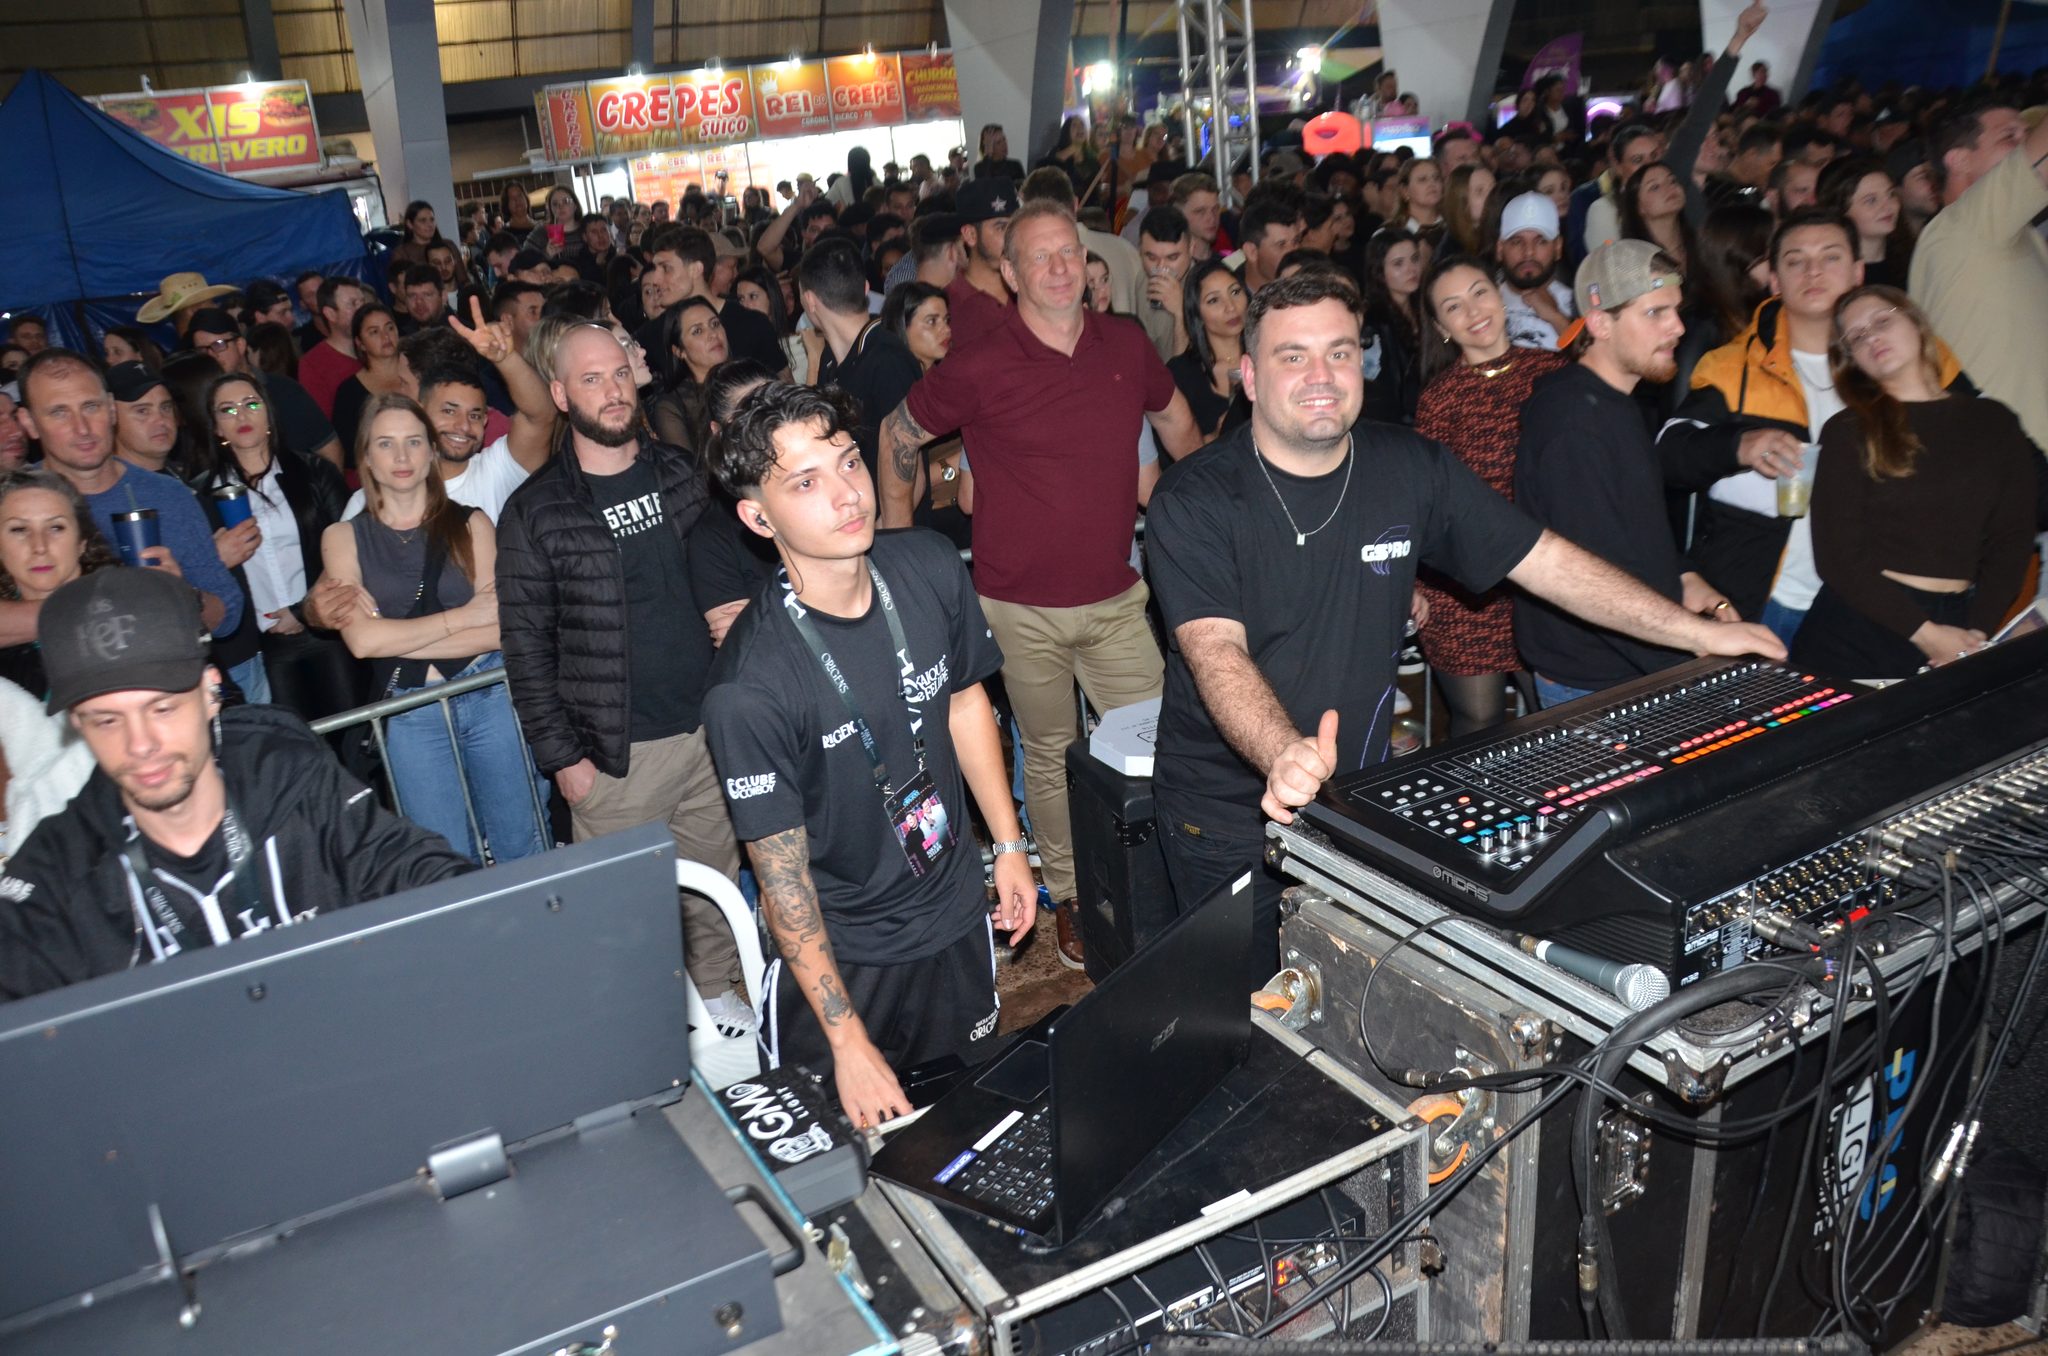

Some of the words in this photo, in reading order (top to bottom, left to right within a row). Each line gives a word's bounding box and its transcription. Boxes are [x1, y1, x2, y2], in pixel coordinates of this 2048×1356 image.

[598, 78, 743, 132] CREPES
[763, 91, 814, 121] REI
[833, 80, 899, 112] CREPE
[167, 101, 261, 142] XIS
[821, 652, 849, 694] ORIGENS
[735, 772, 776, 790] CLUBE
[776, 1086, 810, 1120] LIGHT
